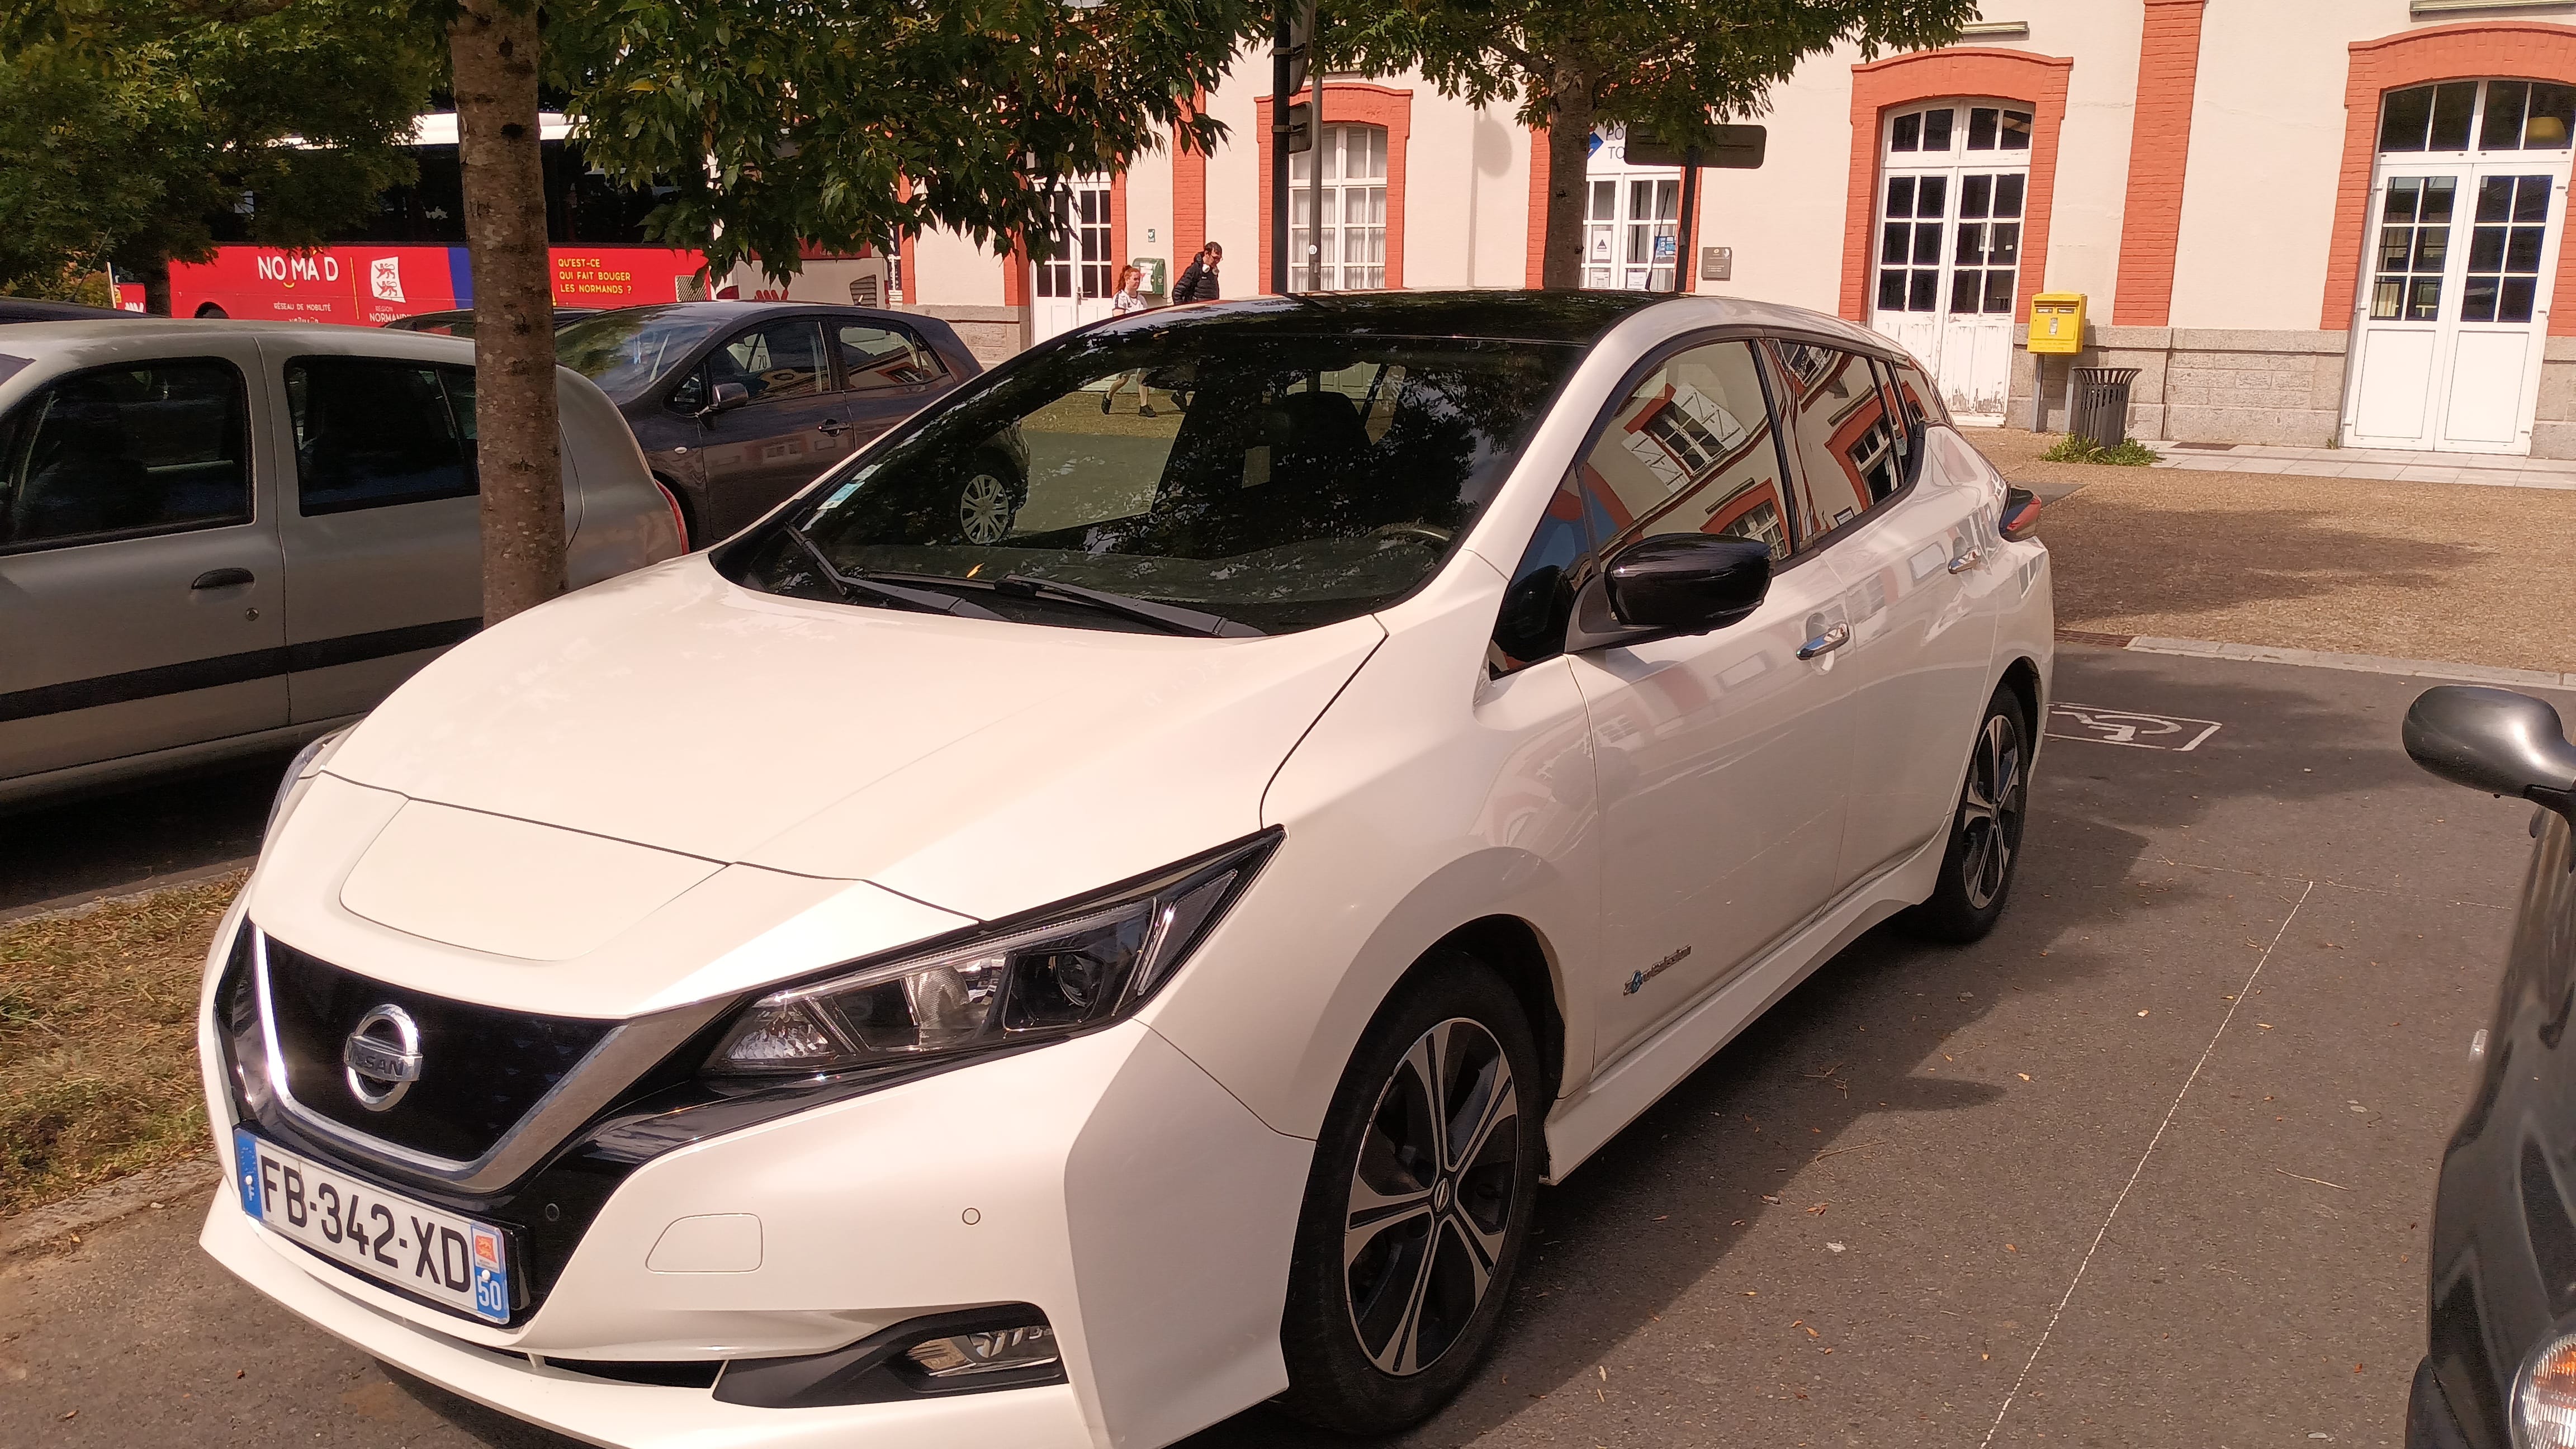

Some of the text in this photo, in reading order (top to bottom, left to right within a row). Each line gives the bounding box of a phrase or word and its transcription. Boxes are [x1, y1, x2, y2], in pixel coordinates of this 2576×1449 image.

[558, 258, 600, 268] QU'EST-CE
[559, 271, 631, 281] QUI FAIT BOUGER
[560, 284, 632, 294] LES NORMANDS ?
[757, 355, 767, 369] 70
[261, 1155, 470, 1293] FB-342-XD
[477, 1274, 502, 1311] 50
